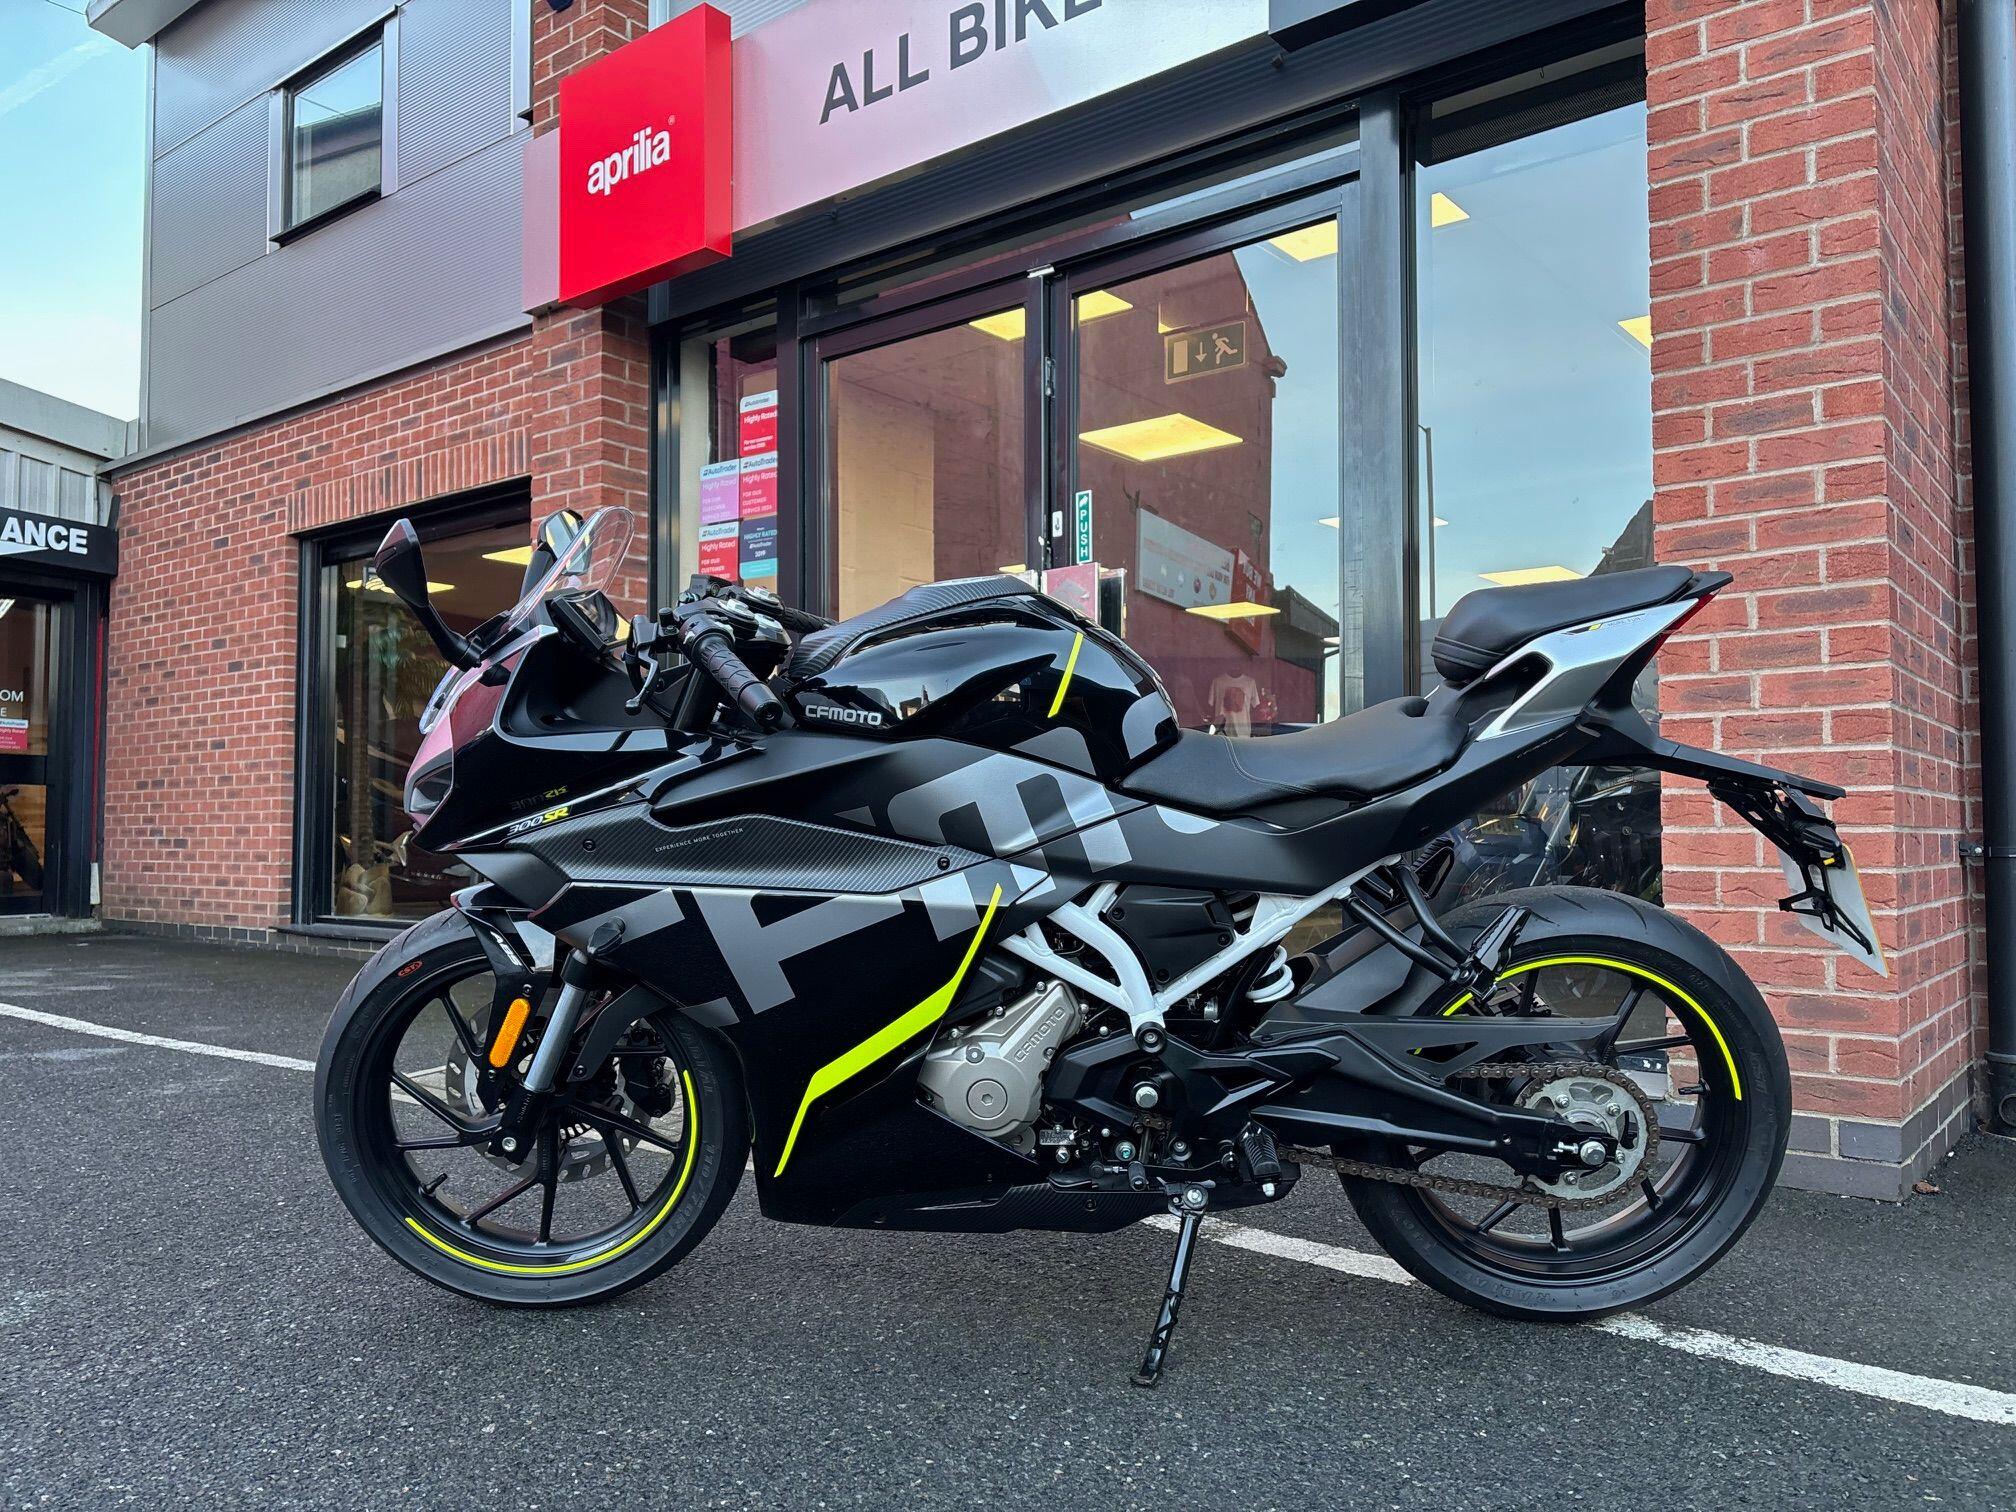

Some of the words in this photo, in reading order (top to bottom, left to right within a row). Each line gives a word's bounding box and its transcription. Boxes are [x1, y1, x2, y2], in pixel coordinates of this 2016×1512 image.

[819, 33, 929, 125] ALL
[587, 126, 670, 196] aprilia
[743, 473, 760, 484] Highly
[0, 517, 88, 555] ANCE
[702, 542, 718, 552] Highly
[1080, 509, 1089, 557] PUSH
[805, 704, 882, 726] CFMOTO
[508, 806, 569, 836] 300SR
[655, 840, 691, 853] EXPERIENCE
[693, 835, 710, 844] MORE
[712, 827, 744, 839] TOGETHER
[490, 931, 523, 966] ABS
[1014, 1006, 1066, 1063] CFMOTO
